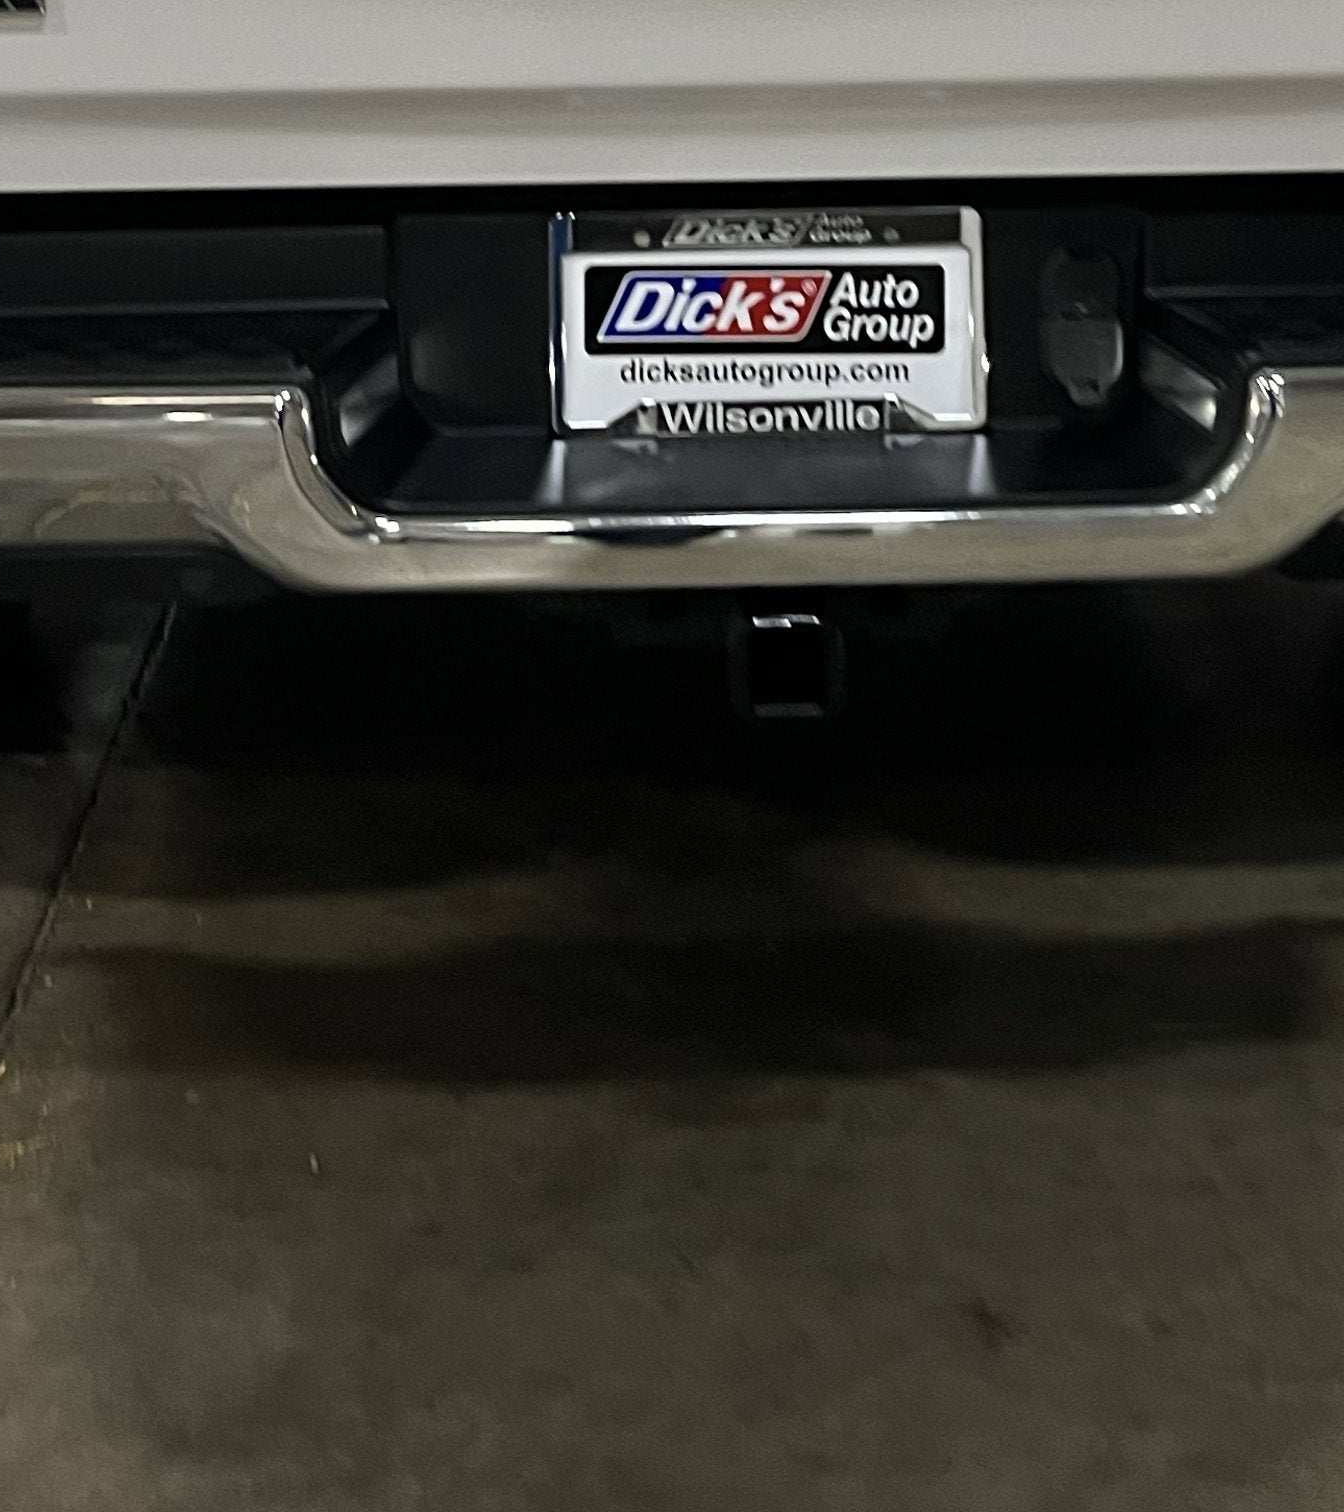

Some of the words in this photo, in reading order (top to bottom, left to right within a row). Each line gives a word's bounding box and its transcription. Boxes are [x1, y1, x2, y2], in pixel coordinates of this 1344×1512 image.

[615, 278, 805, 333] Dick's
[829, 272, 920, 309] Auto
[824, 308, 935, 349] Group
[620, 358, 910, 388] dicksautogroup.com
[659, 398, 881, 435] Wilsonville
